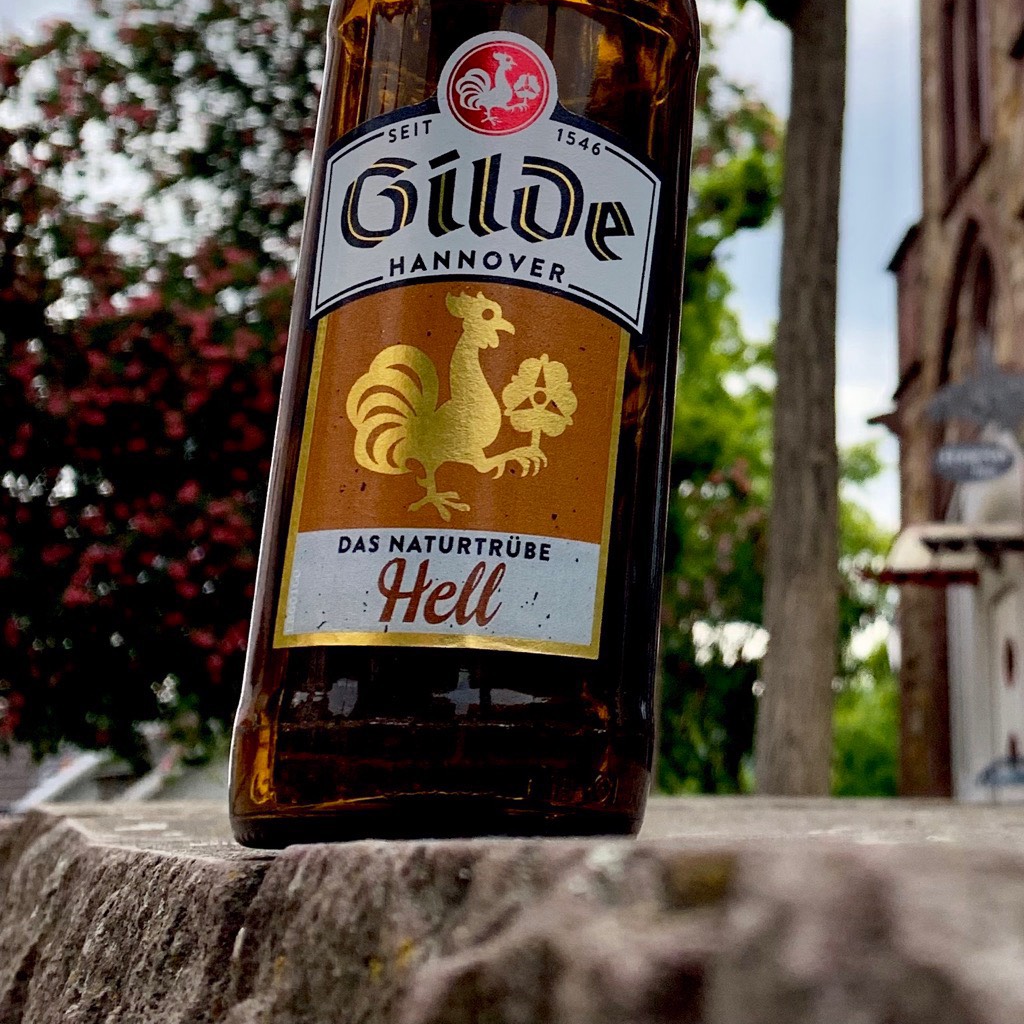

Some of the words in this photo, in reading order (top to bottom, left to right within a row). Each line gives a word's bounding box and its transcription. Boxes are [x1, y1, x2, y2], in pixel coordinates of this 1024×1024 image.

[388, 119, 433, 144] SEIT
[557, 128, 602, 156] 1546
[389, 250, 566, 284] HANNOVER
[338, 535, 380, 554] DAS
[389, 535, 551, 562] NATURTRÜBE
[377, 557, 507, 627] Hell
